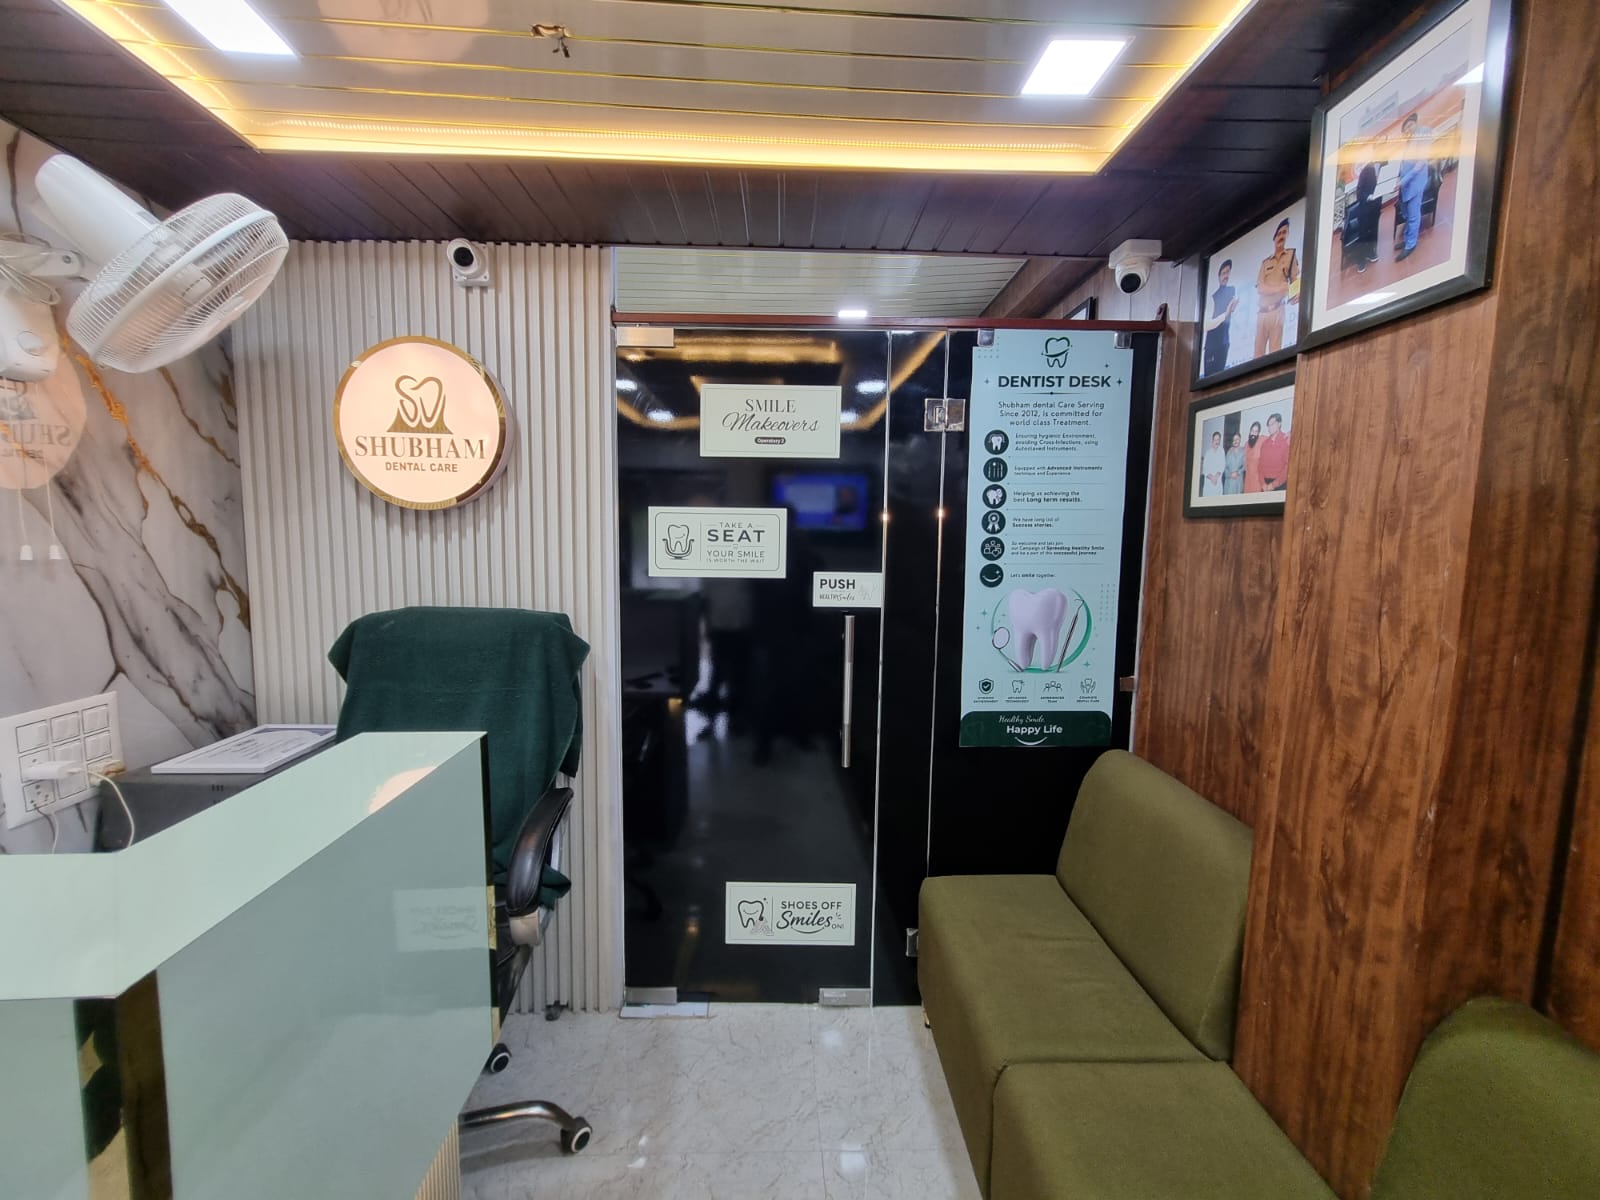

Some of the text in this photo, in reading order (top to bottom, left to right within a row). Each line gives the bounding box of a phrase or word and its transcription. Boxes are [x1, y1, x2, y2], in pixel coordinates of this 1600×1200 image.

[998, 376, 1111, 388] DENTIST DESK
[745, 399, 796, 413] SMILE
[998, 401, 1105, 410] Shubham dental Care Serving
[1021, 410, 1040, 418] 2012,
[722, 411, 819, 431] Makeovers
[355, 435, 486, 459] SHUBHAM
[385, 462, 458, 473] DENTAL CARE
[707, 529, 765, 543] SEAT
[707, 550, 766, 558] YOUR SMILE
[820, 579, 856, 590] PUSH
[998, 714, 1023, 724] Healthy
[1006, 724, 1063, 735] Happy Life
[781, 901, 842, 910] SHOES OFF
[776, 910, 833, 929] Smiles
